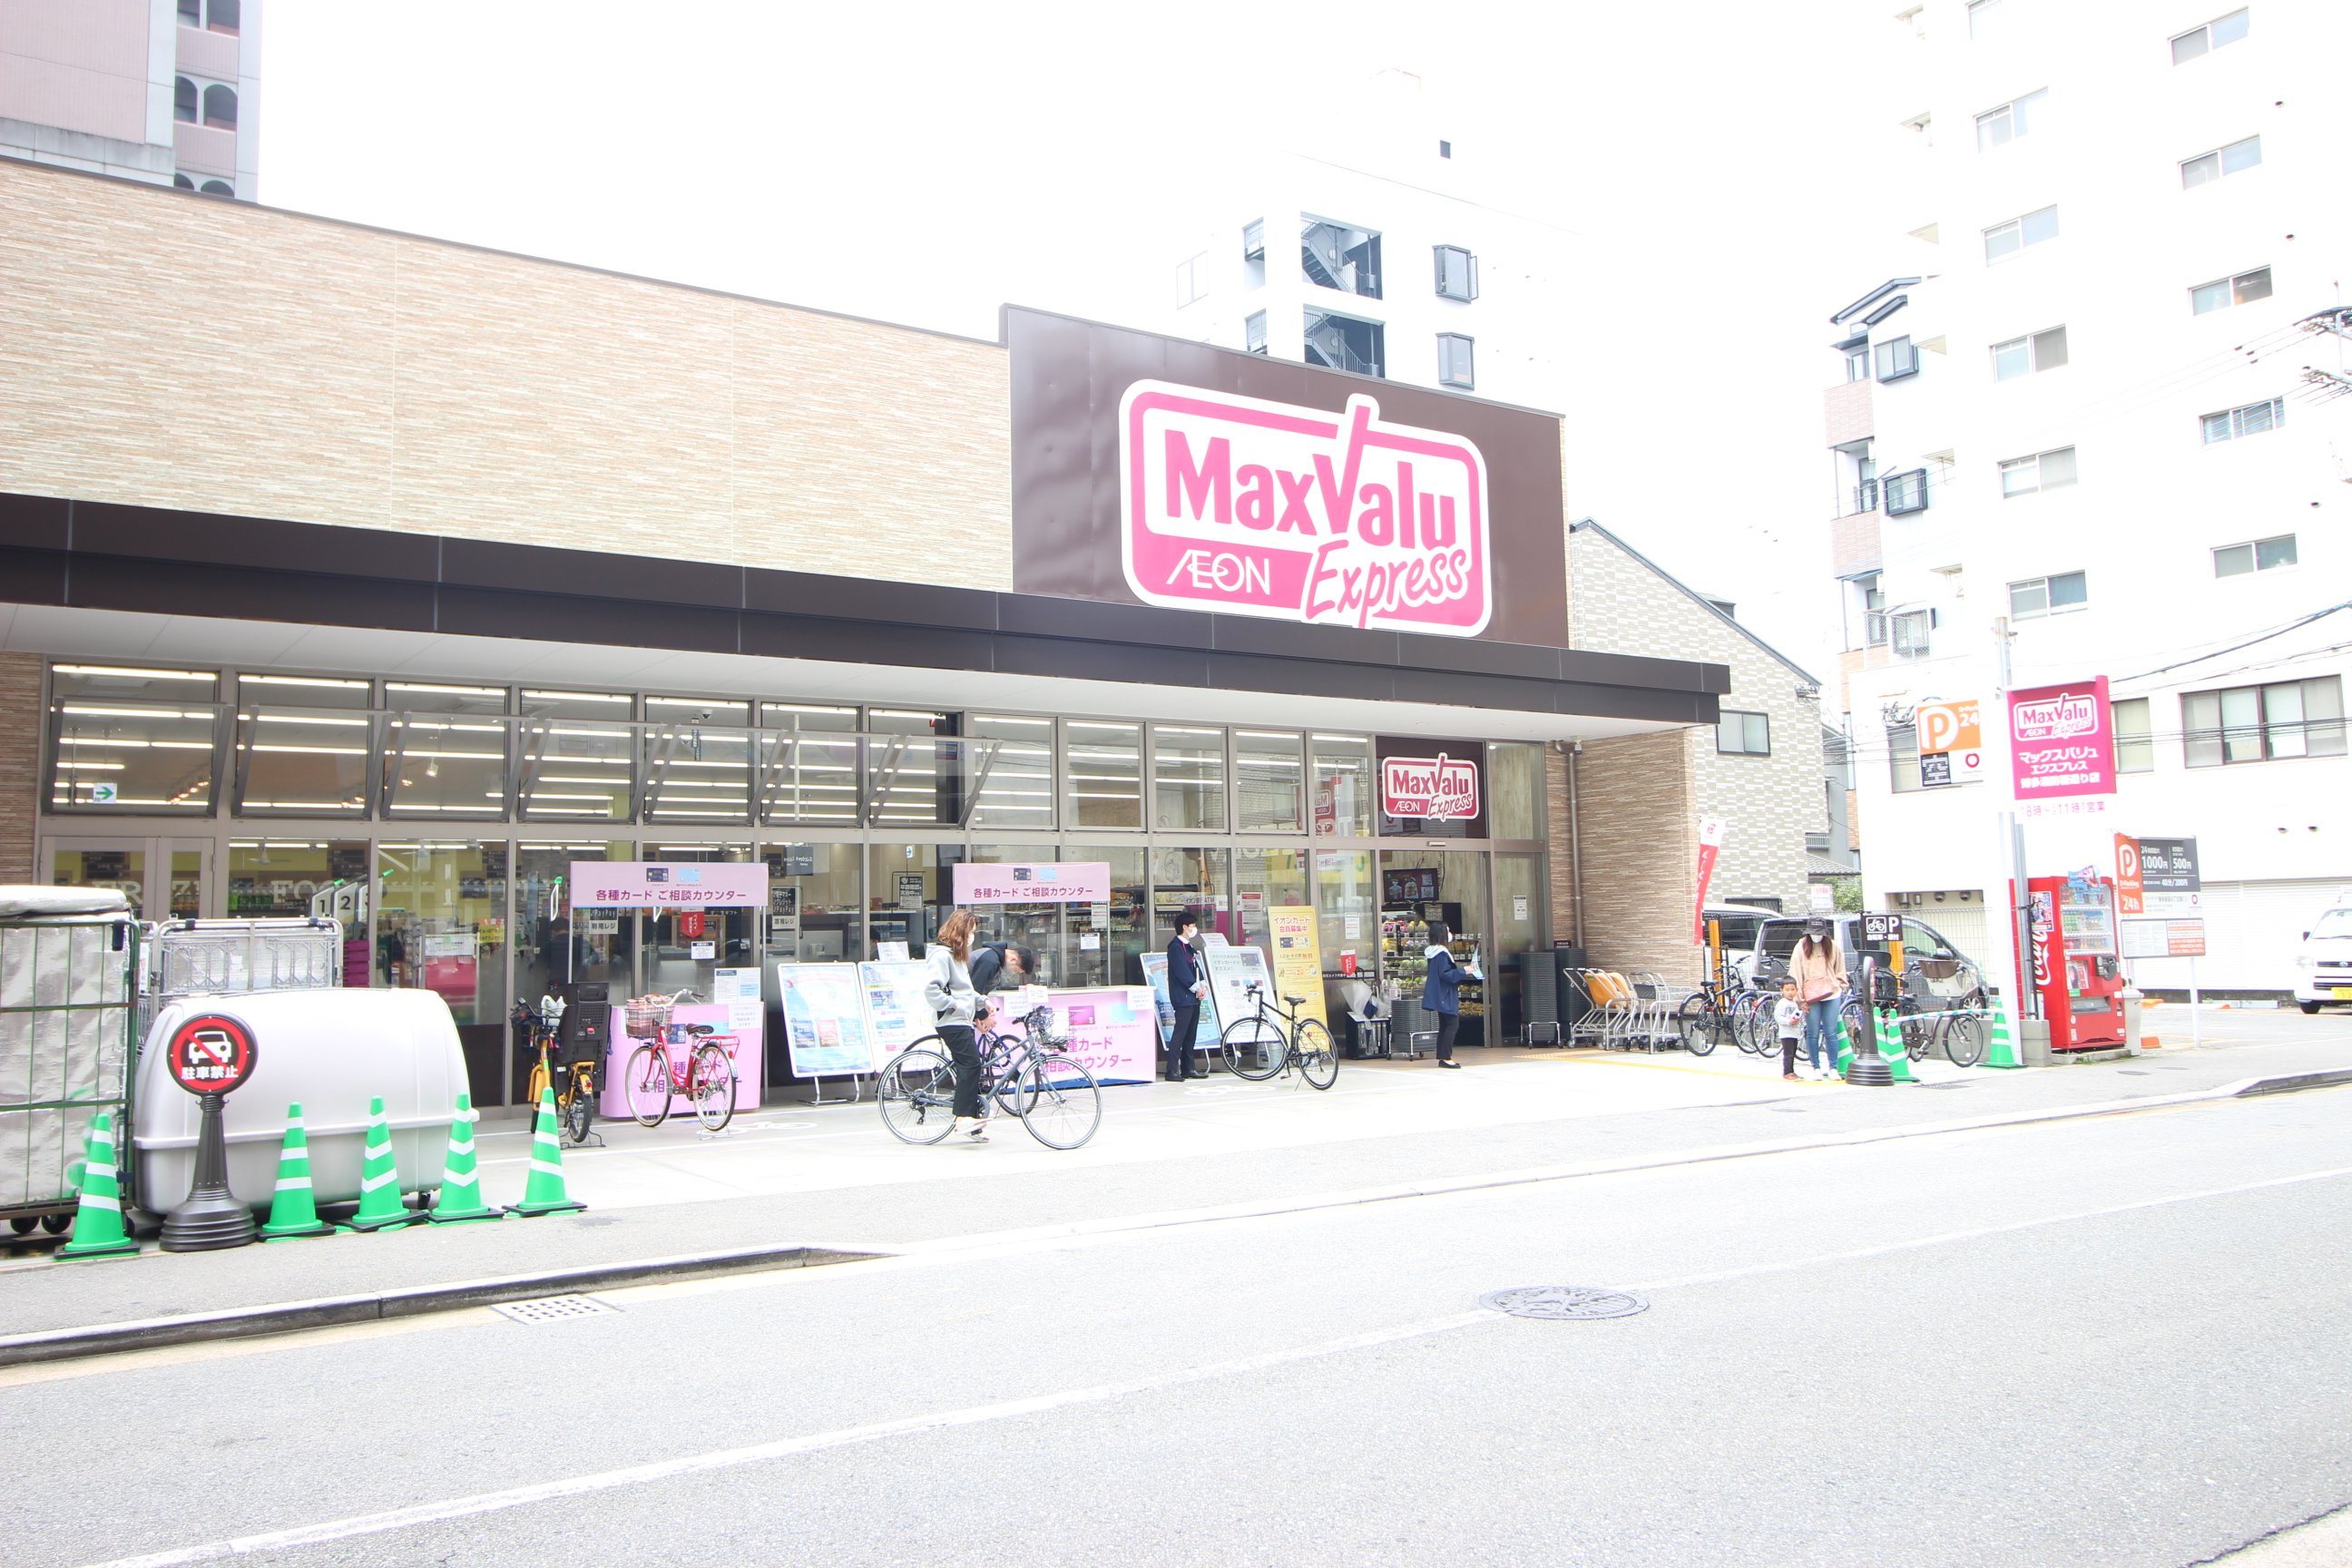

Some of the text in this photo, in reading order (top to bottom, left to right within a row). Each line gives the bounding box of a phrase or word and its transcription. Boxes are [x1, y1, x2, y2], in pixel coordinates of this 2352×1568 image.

[1163, 405, 1456, 550] MaxValu
[1305, 539, 1467, 629] Express
[2023, 694, 2088, 725] MaxValu
[1959, 711, 1979, 727] 24
[2052, 717, 2091, 738] Express
[2017, 747, 2099, 764] マックスバリュ
[1392, 755, 1469, 796] MaxValu
[2030, 760, 2088, 775] エクスプレス
[1427, 793, 1472, 819] Express
[595, 888, 747, 901] 各種カード ご相談カウンター
[974, 887, 1094, 898] 各種カード ご相談カウンター
[319, 898, 326, 913] 1
[340, 895, 351, 910] 2
[1888, 916, 1900, 933] P
[181, 1064, 240, 1081] 駐車禁止
